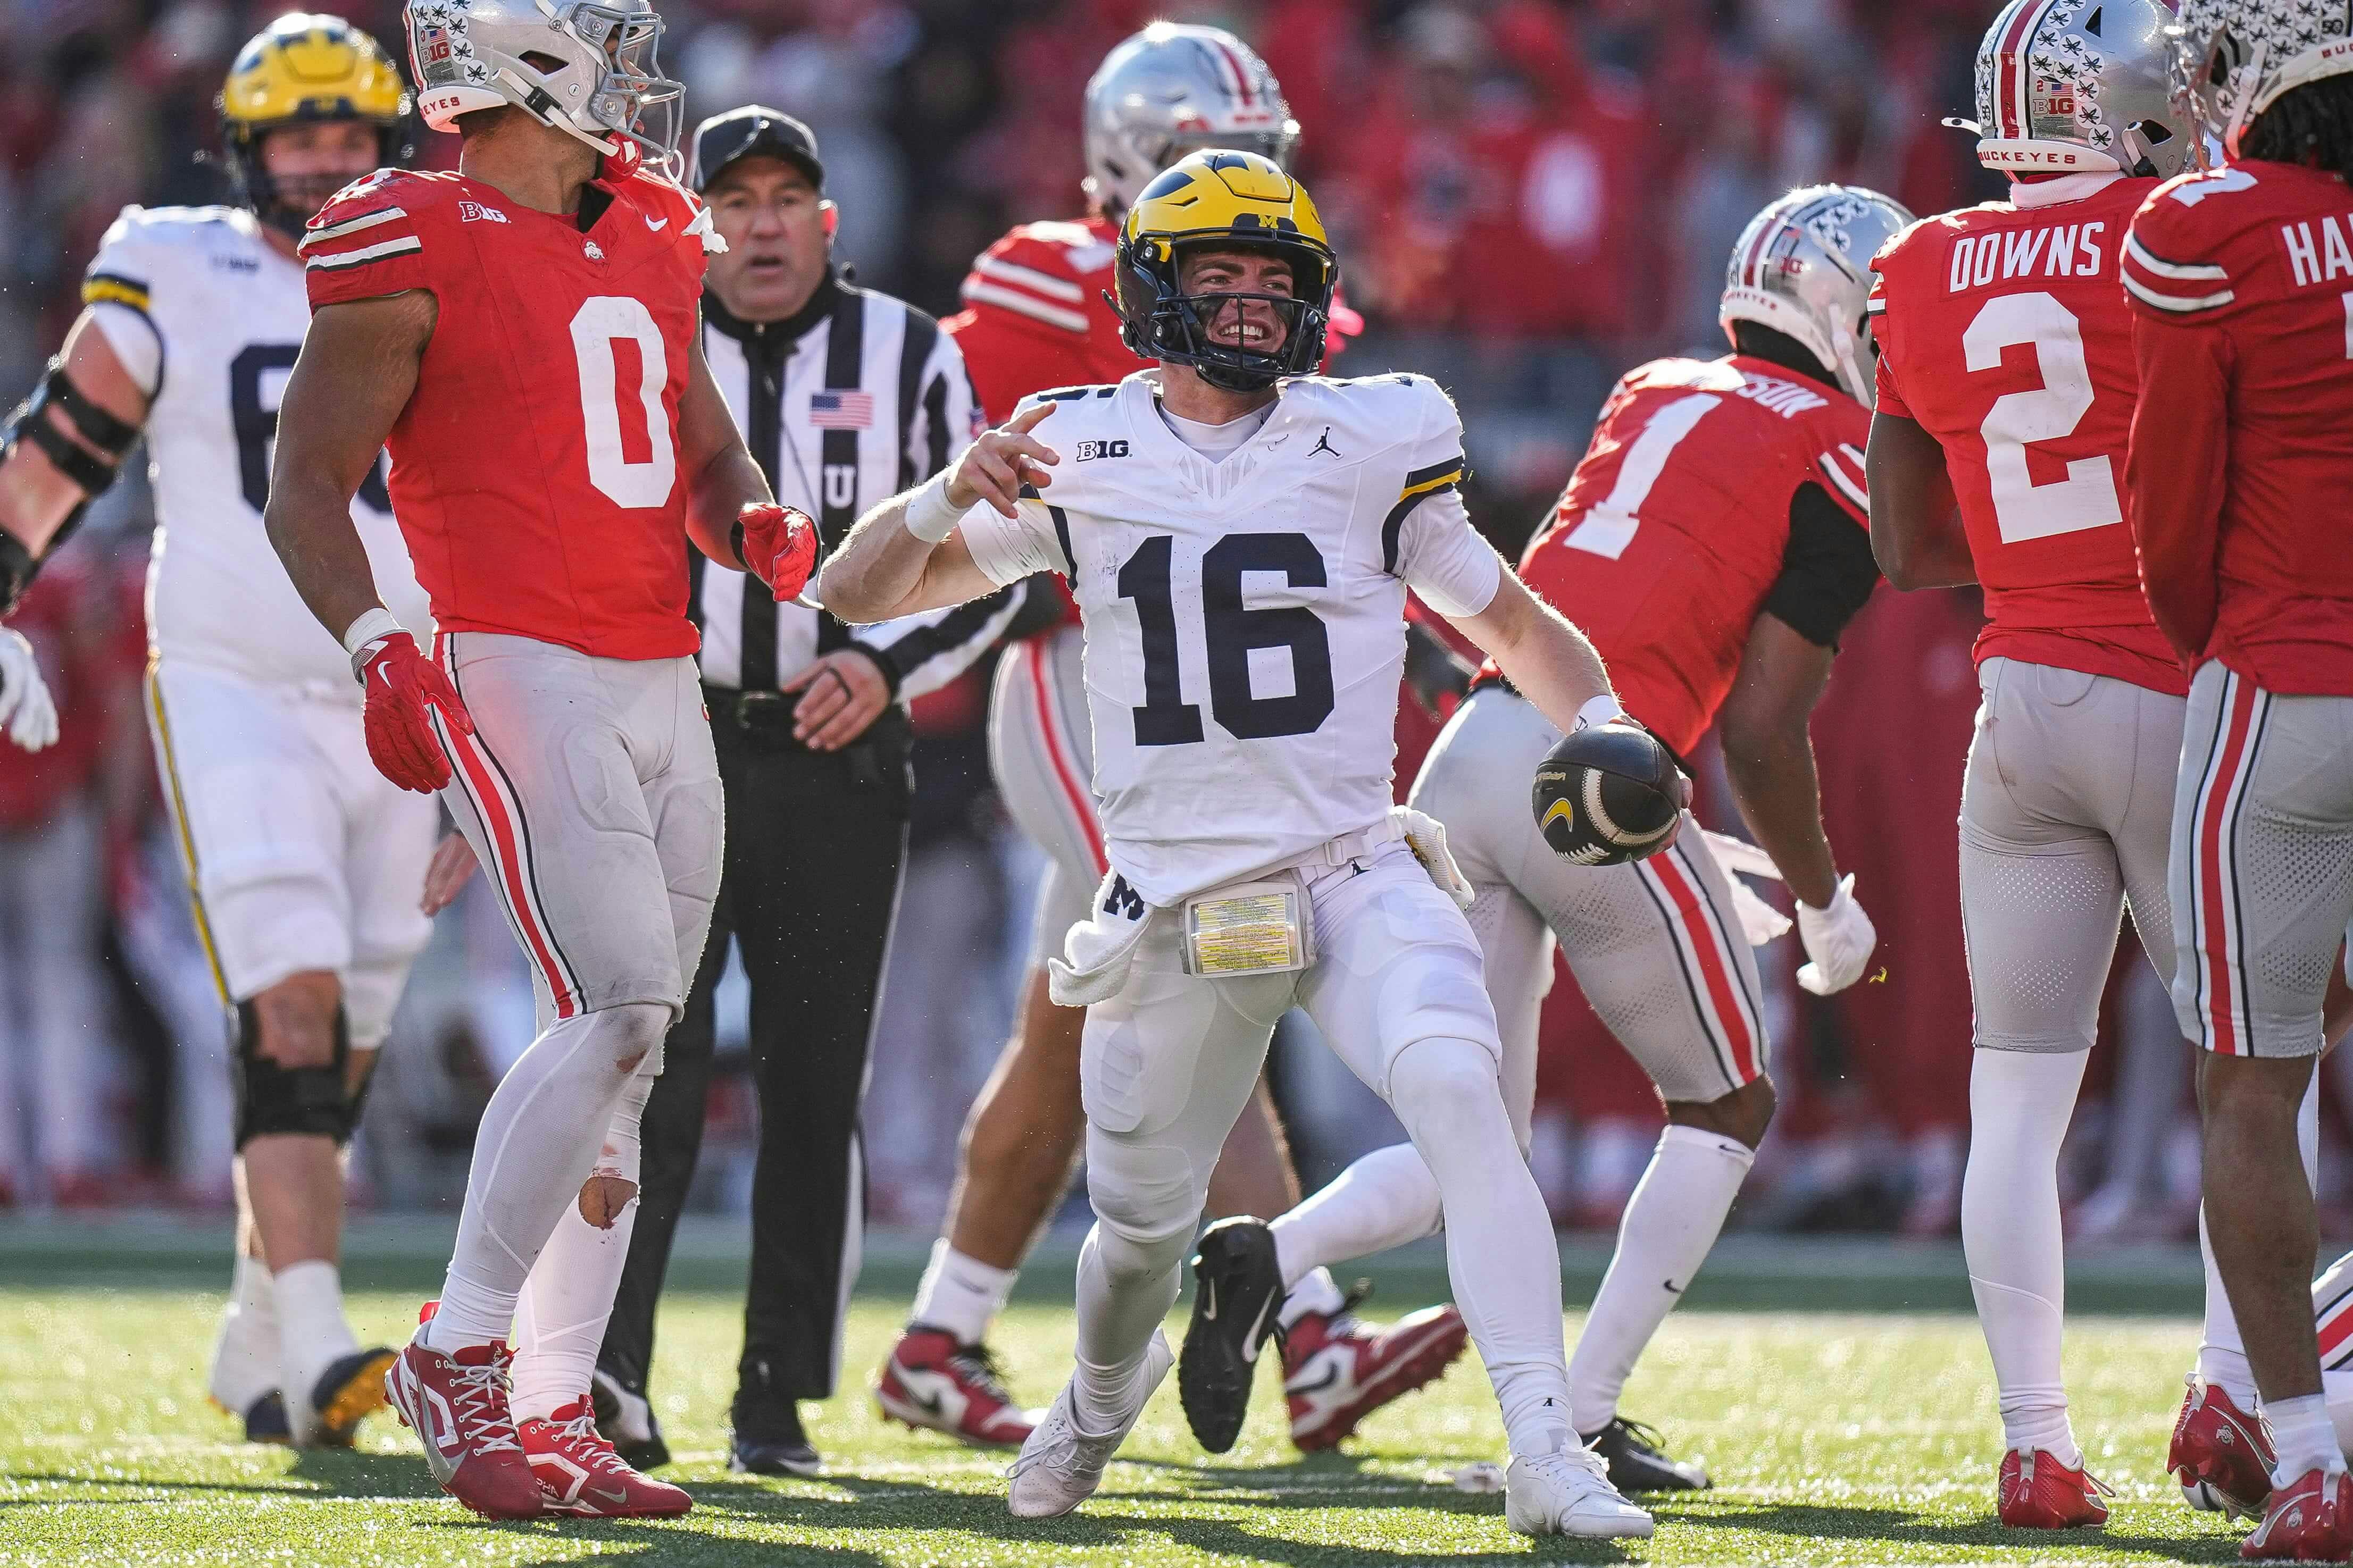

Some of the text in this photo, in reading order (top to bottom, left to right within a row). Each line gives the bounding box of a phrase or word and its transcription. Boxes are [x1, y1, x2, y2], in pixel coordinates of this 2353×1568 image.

[2037, 80, 2043, 91] 2
[1258, 214, 1279, 229] M
[1950, 221, 2105, 293] DOWNS
[2281, 213, 2353, 287] HA
[569, 296, 676, 508] 0
[1963, 292, 2123, 544] 2
[824, 465, 856, 507] U
[1563, 392, 1722, 561] 1
[1118, 533, 1334, 746] 16
[1103, 873, 1145, 921] M
